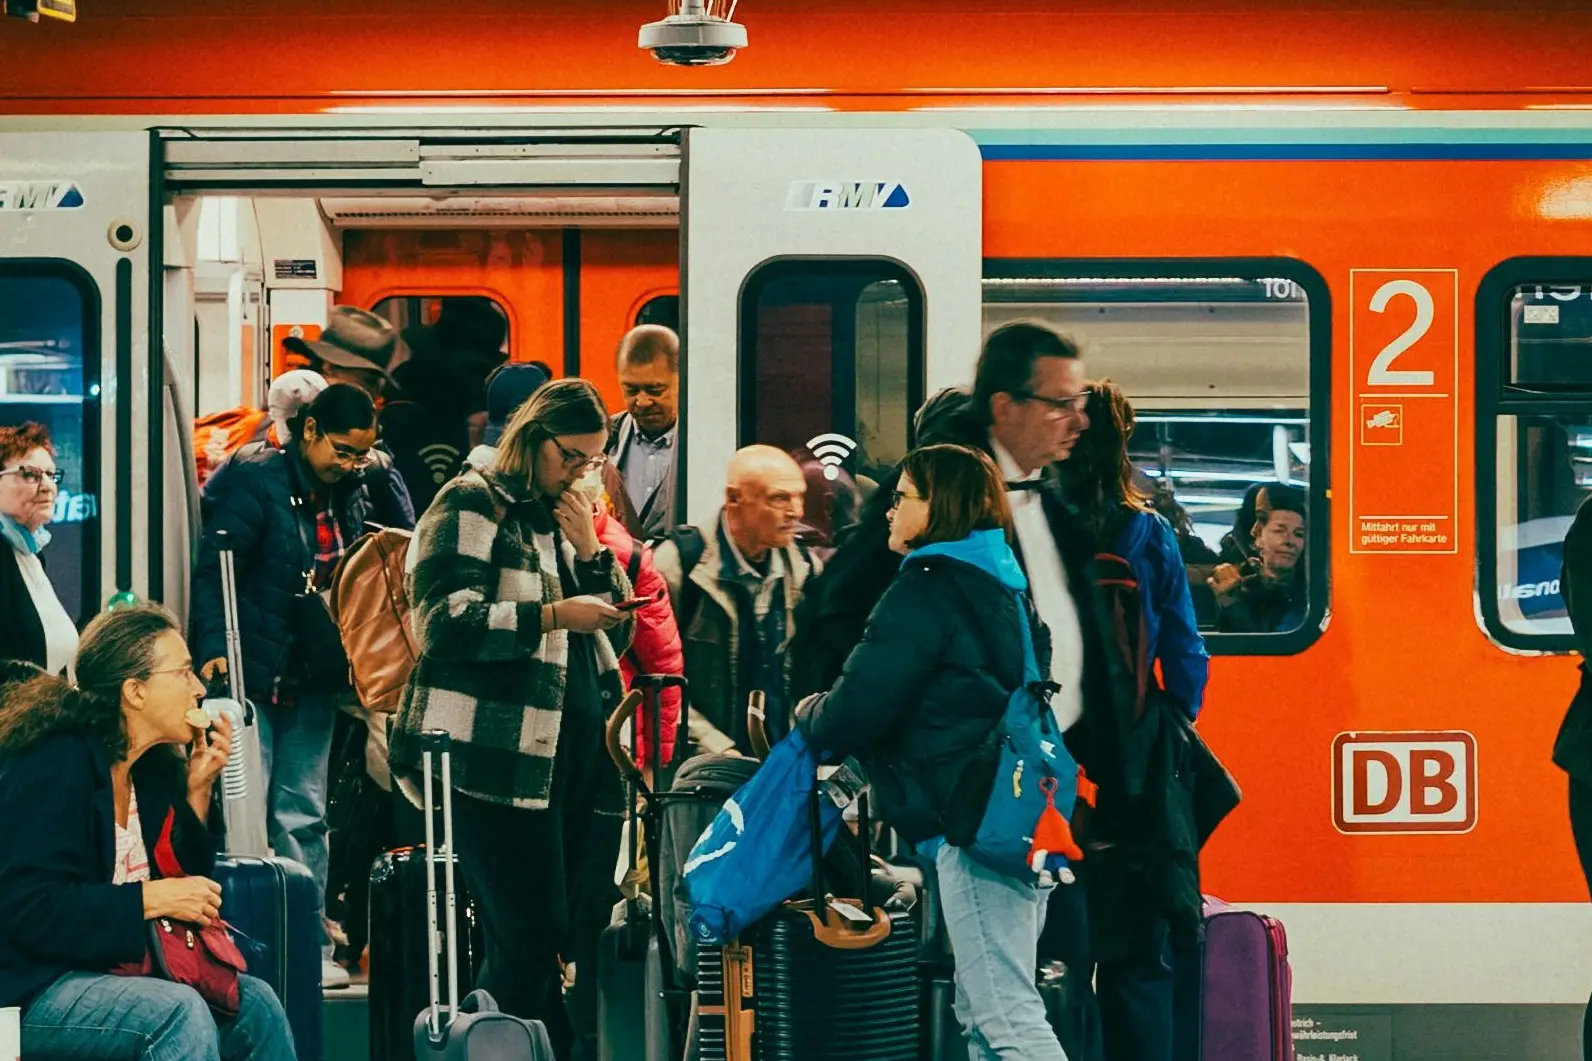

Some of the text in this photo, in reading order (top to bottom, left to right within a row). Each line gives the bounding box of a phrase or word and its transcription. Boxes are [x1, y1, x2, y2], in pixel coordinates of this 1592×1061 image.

[808, 182, 900, 209] RMV
[1367, 279, 1435, 386] 2
[1361, 522, 1436, 532] Mitfahrt nur mit
[1400, 533, 1448, 544] Fahrkarte
[1353, 749, 1458, 816] DB
